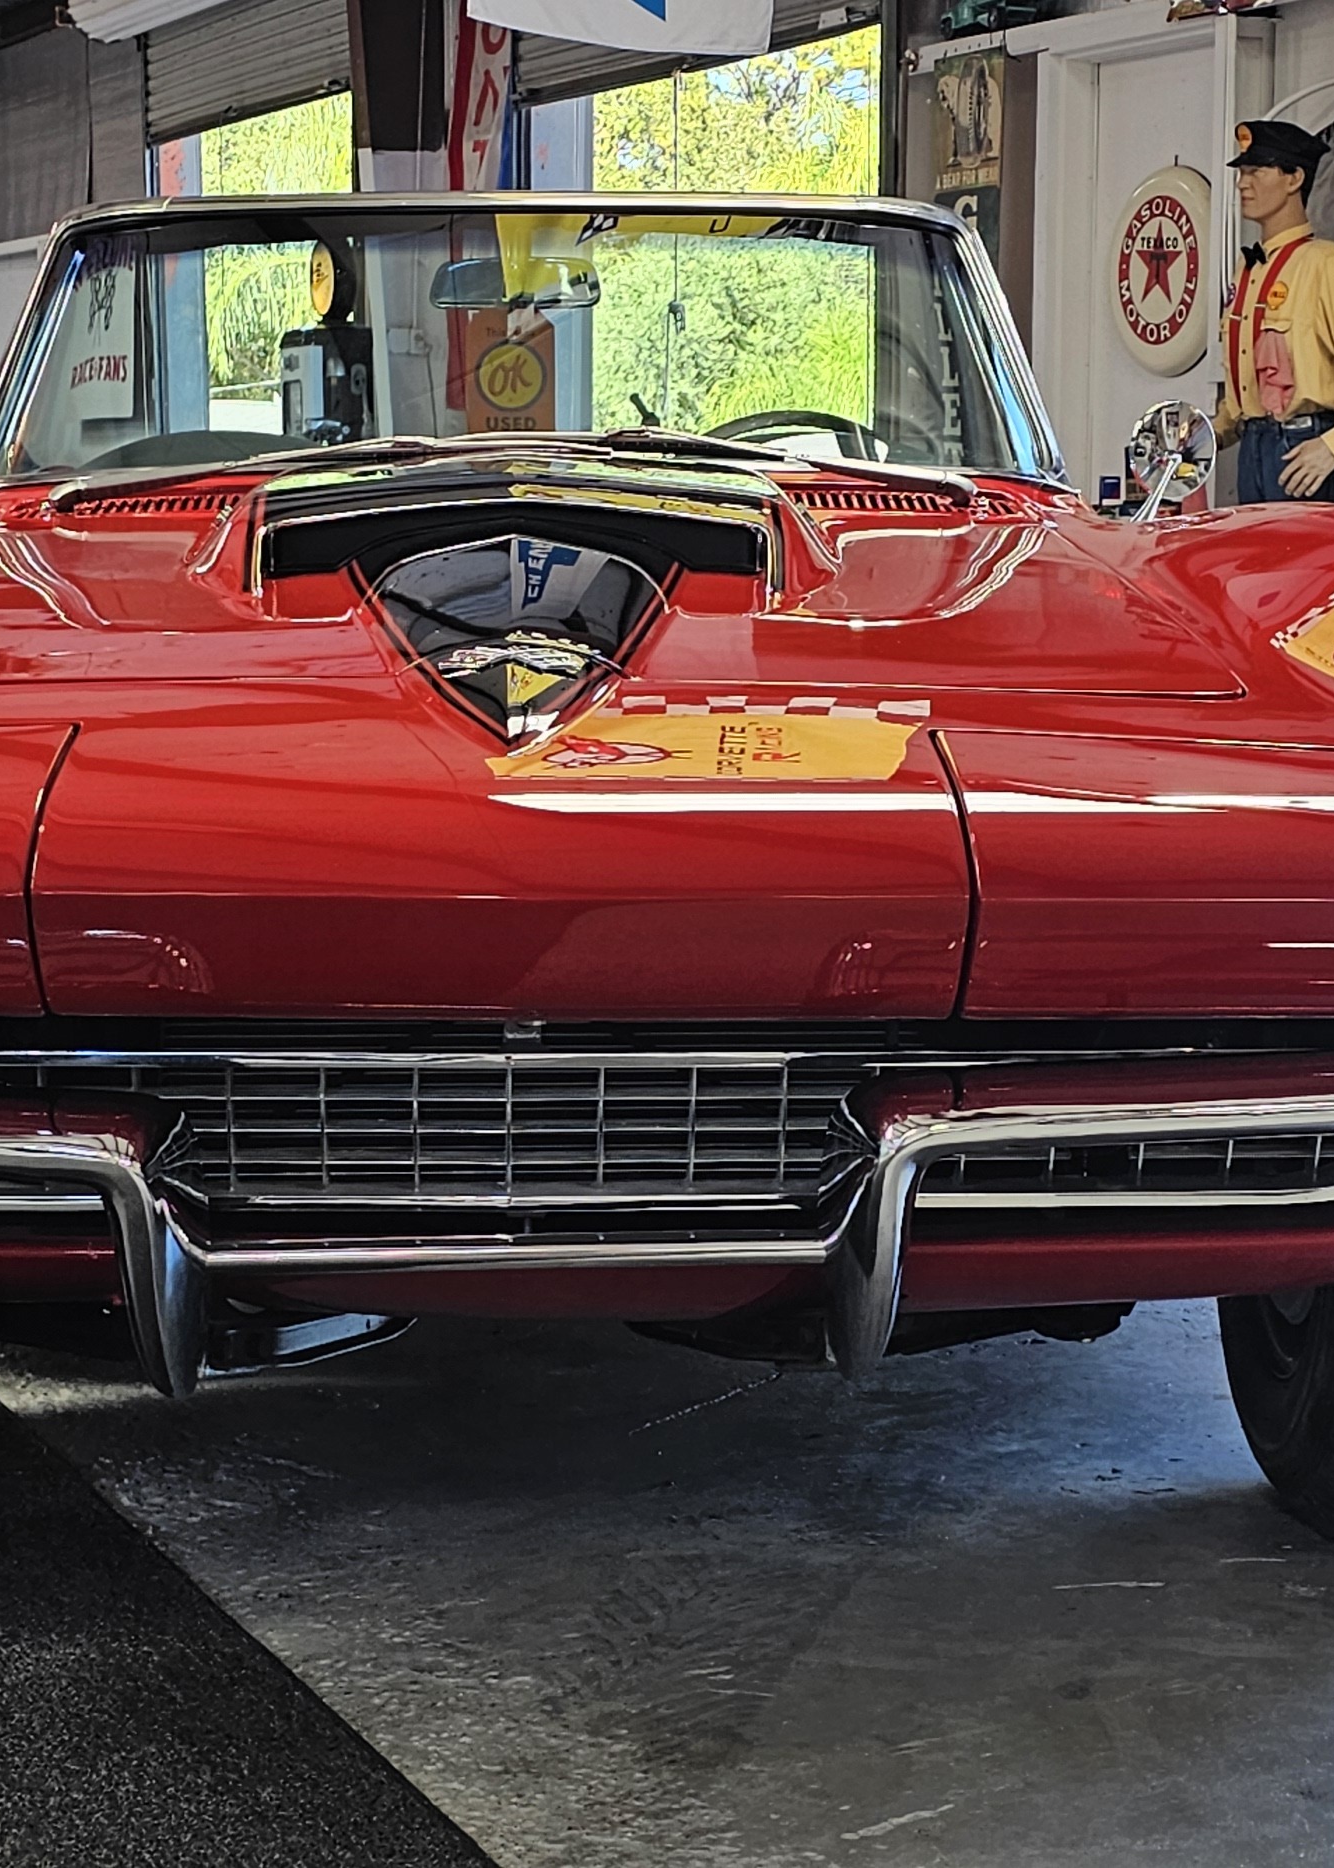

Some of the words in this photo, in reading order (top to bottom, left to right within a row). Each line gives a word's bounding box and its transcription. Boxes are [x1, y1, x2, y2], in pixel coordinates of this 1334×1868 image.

[1122, 197, 1197, 255] GASOLINE
[1119, 278, 1171, 343] MOTOR
[1175, 276, 1197, 323] OIL
[97, 354, 129, 383] FANS
[487, 353, 533, 397] OK
[485, 416, 537, 430] USED
